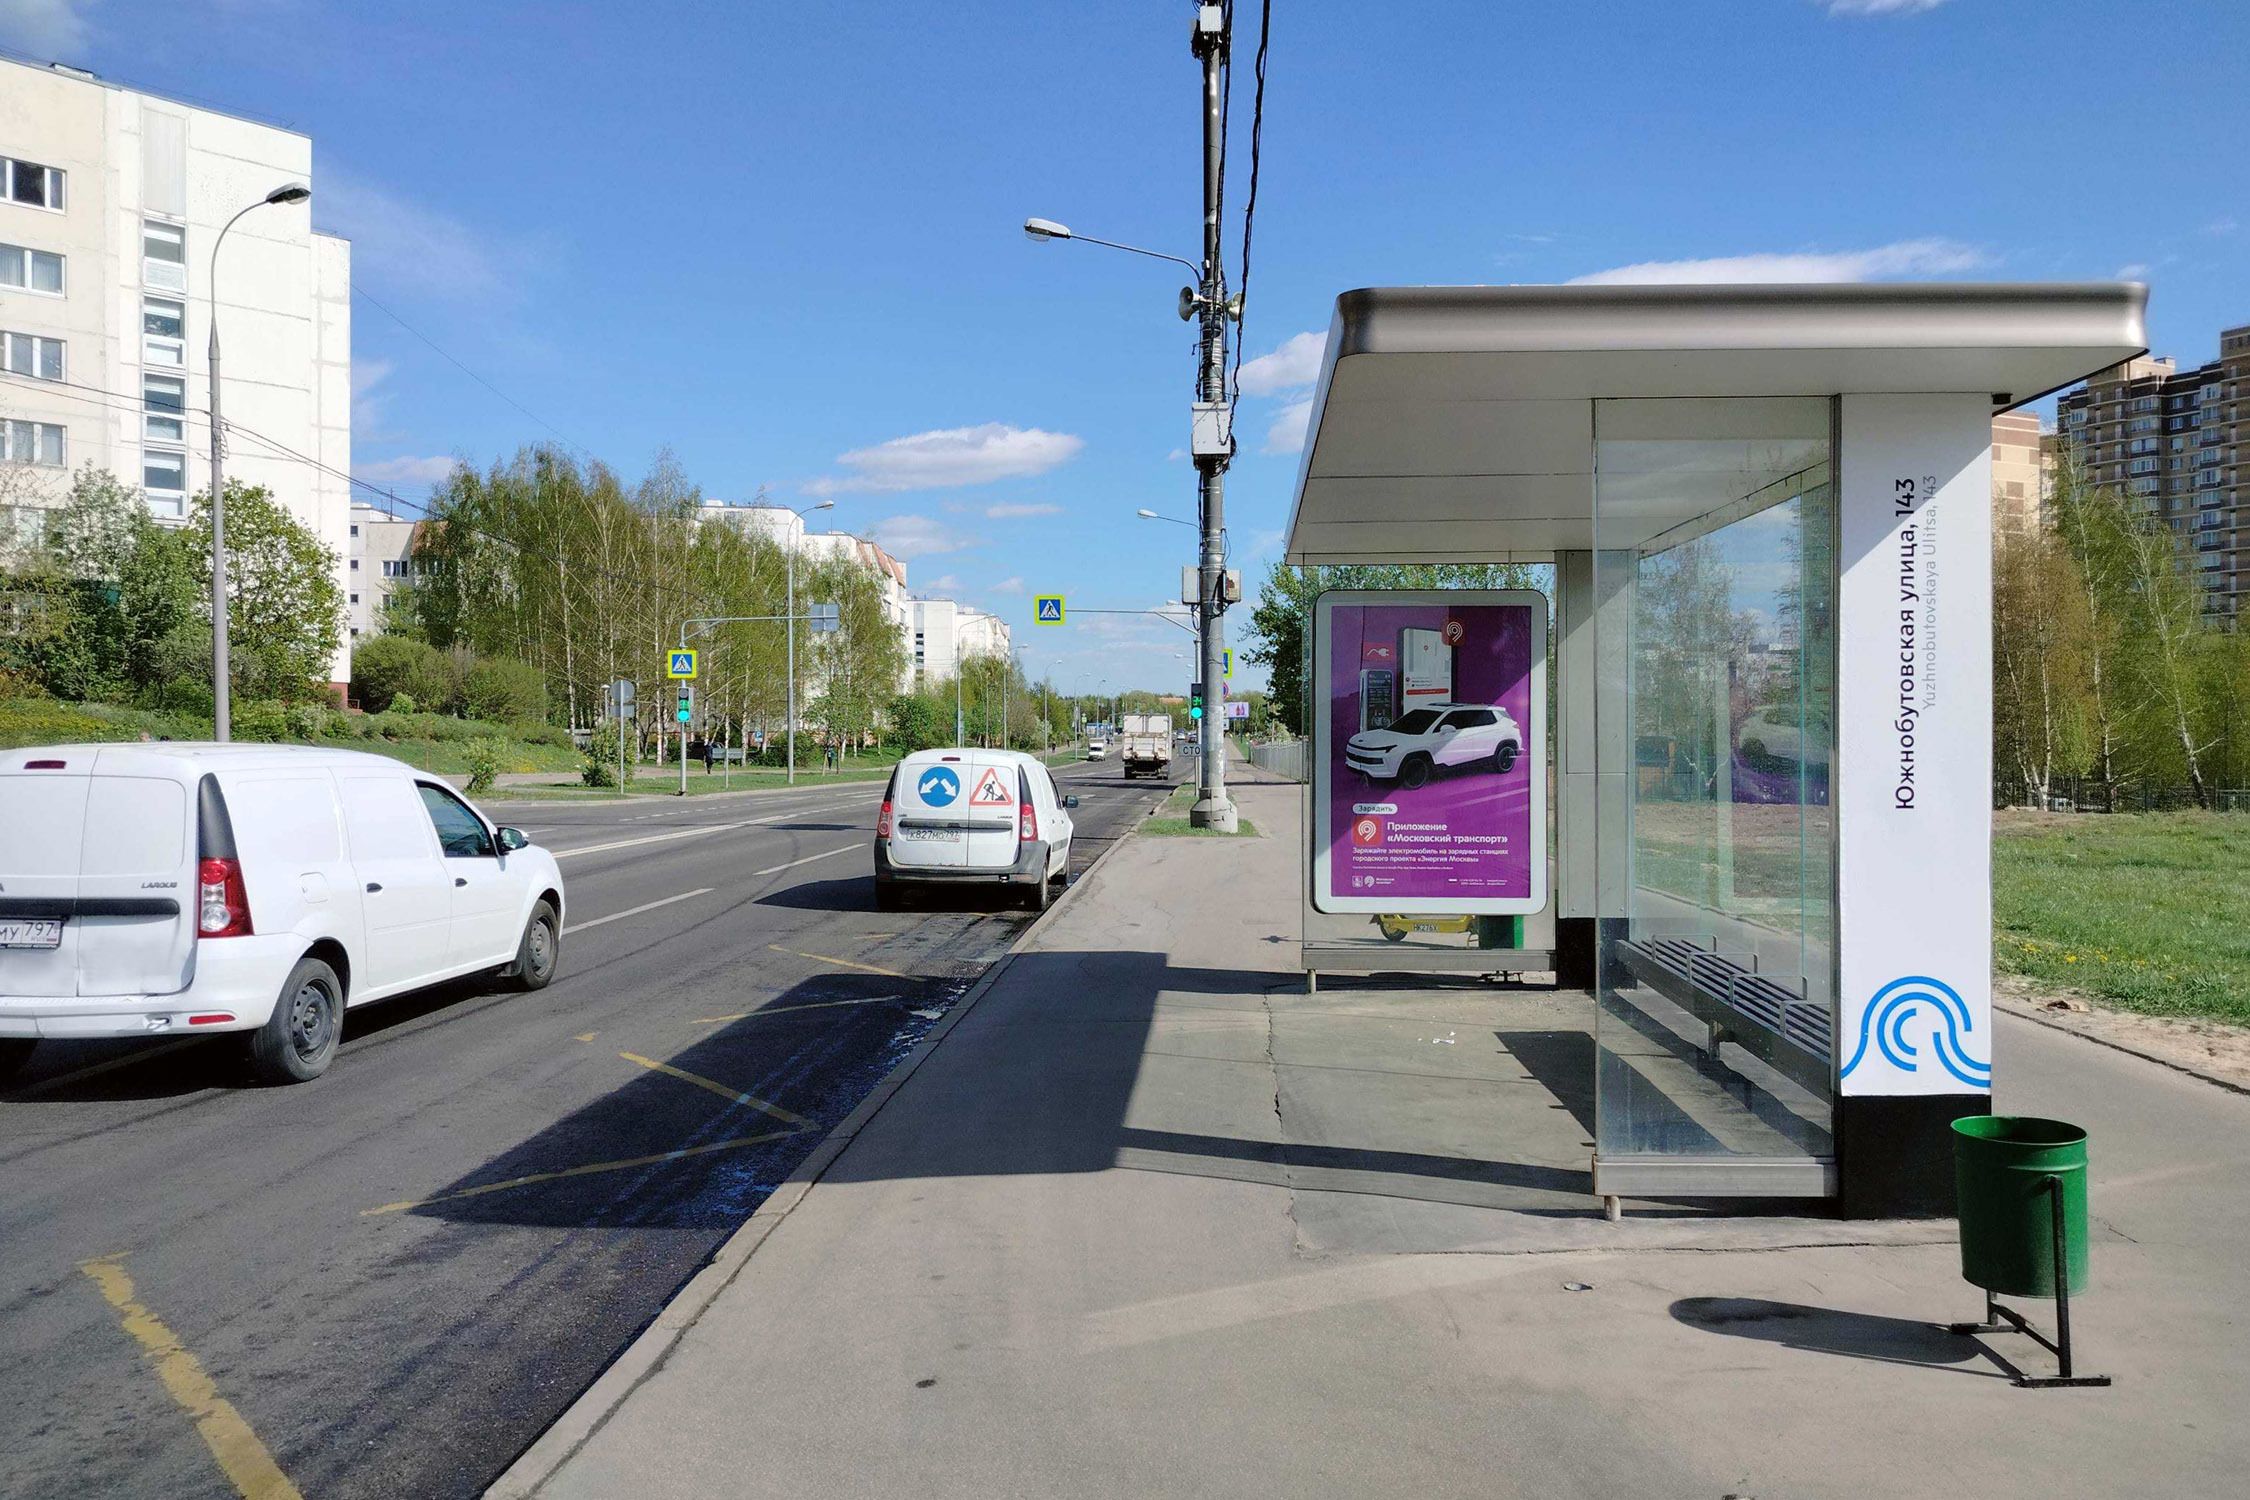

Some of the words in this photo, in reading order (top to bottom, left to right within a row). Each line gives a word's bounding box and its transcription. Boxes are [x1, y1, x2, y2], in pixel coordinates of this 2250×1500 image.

[1895, 477, 1915, 517] 143
[1922, 475, 1937, 501] 143
[1922, 504, 1939, 556] Ulitsa,
[1899, 523, 1919, 602] улица,
[1922, 560, 1938, 711] Yuzhnobutovskaya
[1895, 609, 1919, 809] Южнобутовская
[1183, 746, 1200, 754] СТО
[1387, 822, 1447, 831] Приложение
[1387, 834, 1451, 843] «Московский
[1453, 836, 1508, 844] транспорт»
[25, 922, 55, 936] 797
